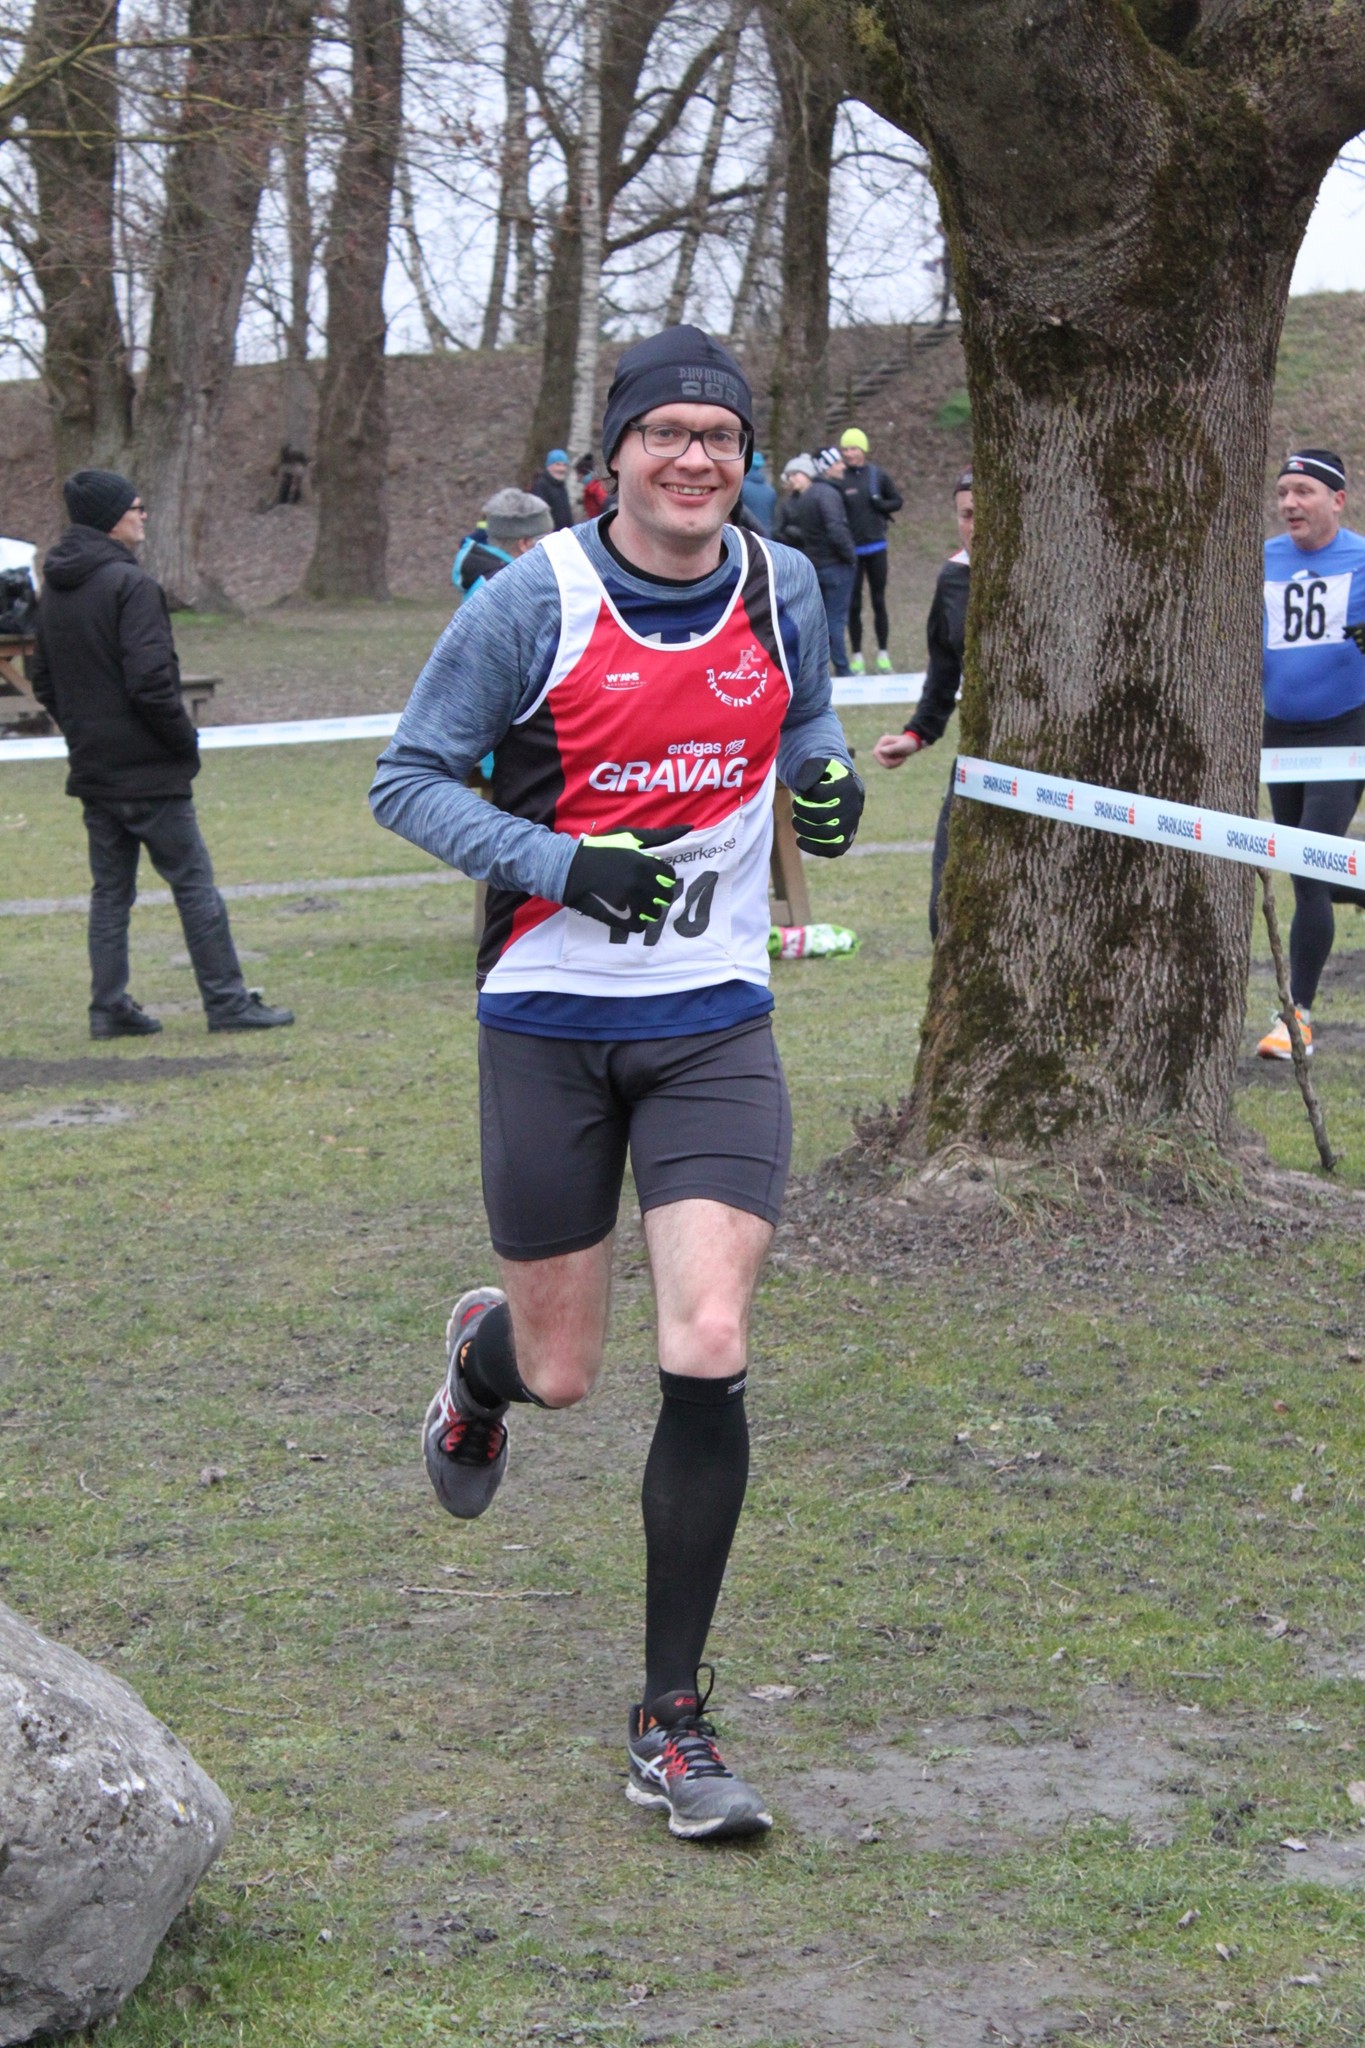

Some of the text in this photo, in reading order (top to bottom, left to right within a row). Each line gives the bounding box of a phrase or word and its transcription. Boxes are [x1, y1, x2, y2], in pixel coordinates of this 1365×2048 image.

[706, 666, 768, 707] RHEINTAL
[667, 740, 722, 757] erdgas
[588, 758, 748, 792] GRAVAG
[982, 774, 1012, 796] SPARKASSE
[1036, 786, 1067, 809] SPARKASSE
[1094, 800, 1129, 824] SPARKASSE
[1157, 814, 1194, 839] SPARKASSE
[1226, 829, 1268, 855] SPARKASSE
[1302, 846, 1348, 874] SPARKASSE
